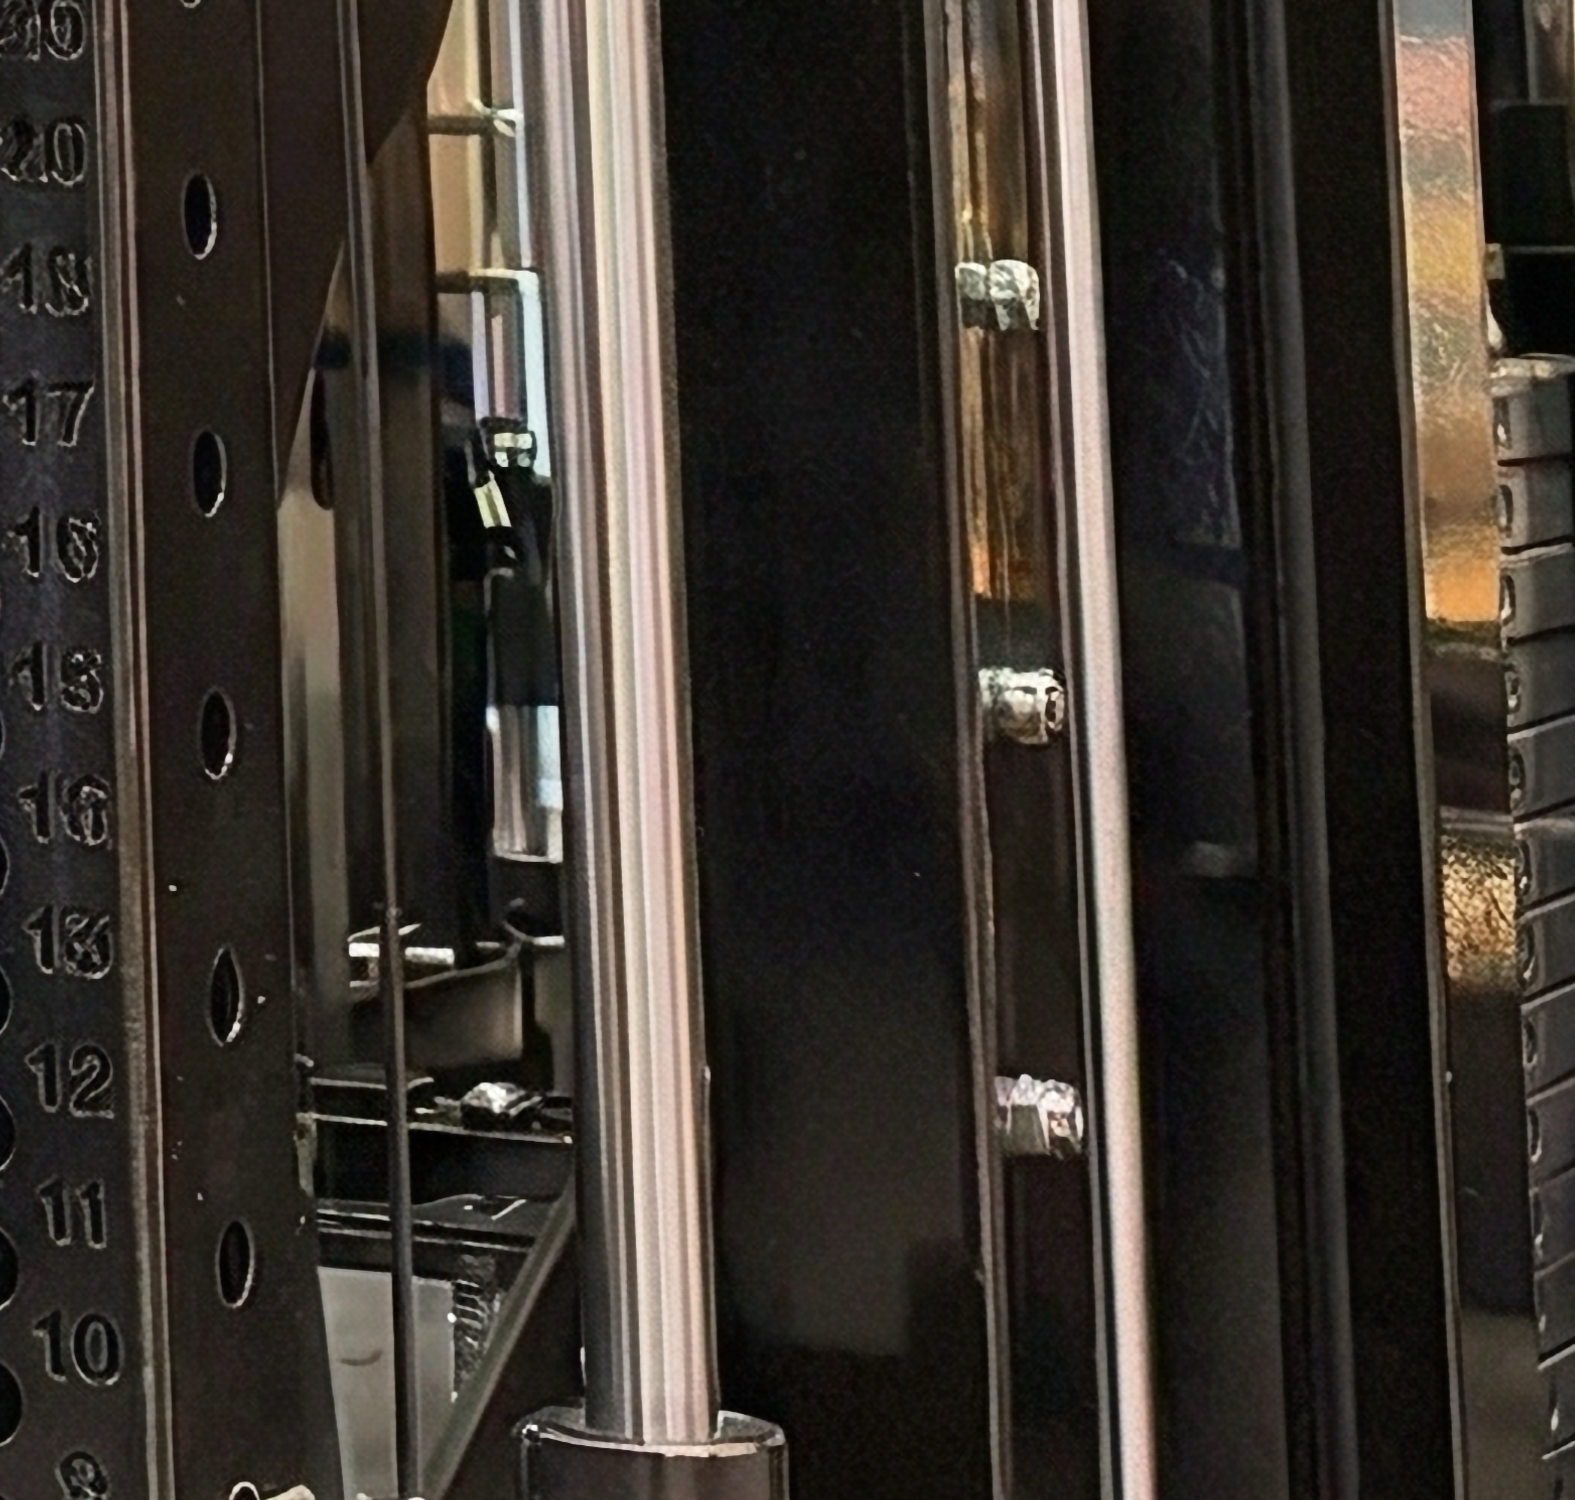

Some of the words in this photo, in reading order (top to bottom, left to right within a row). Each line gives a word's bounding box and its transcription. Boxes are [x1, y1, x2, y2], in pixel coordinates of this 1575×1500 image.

[2, 377, 95, 448] 17
[23, 1042, 115, 1119] 12
[34, 1176, 108, 1250] 11
[33, 1308, 122, 1386] 10
